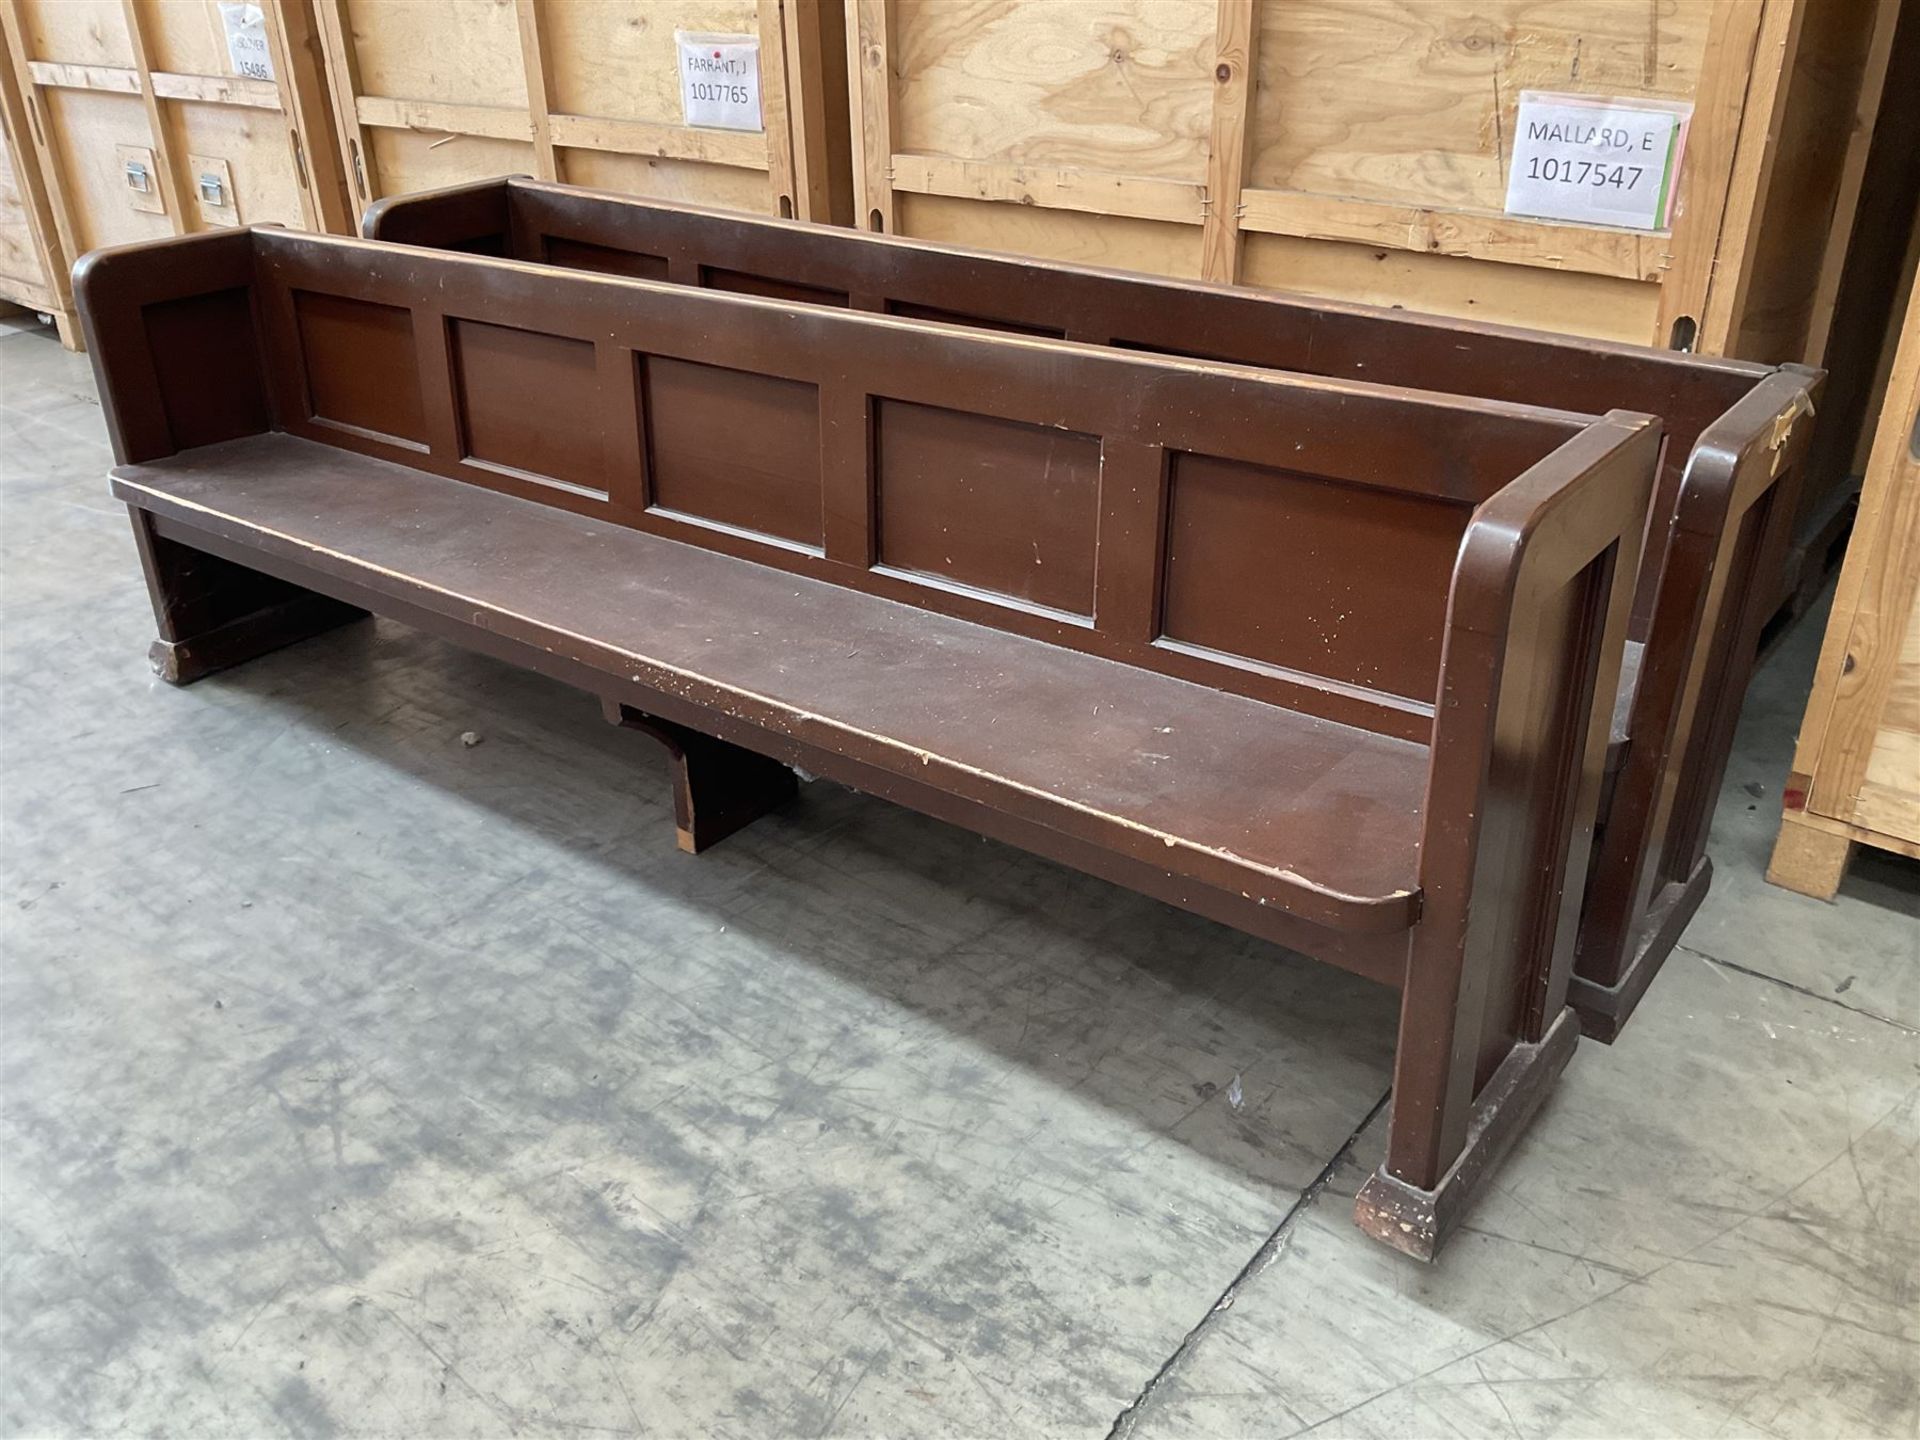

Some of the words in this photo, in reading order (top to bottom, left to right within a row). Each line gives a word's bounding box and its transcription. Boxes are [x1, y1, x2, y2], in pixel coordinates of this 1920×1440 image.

[688, 57, 740, 76] FARRANT,
[742, 61, 747, 74] J
[691, 83, 749, 104] 1017765
[1528, 122, 1633, 152] MALLARD,
[1642, 132, 1655, 151] E
[1527, 156, 1643, 190] 1017547
